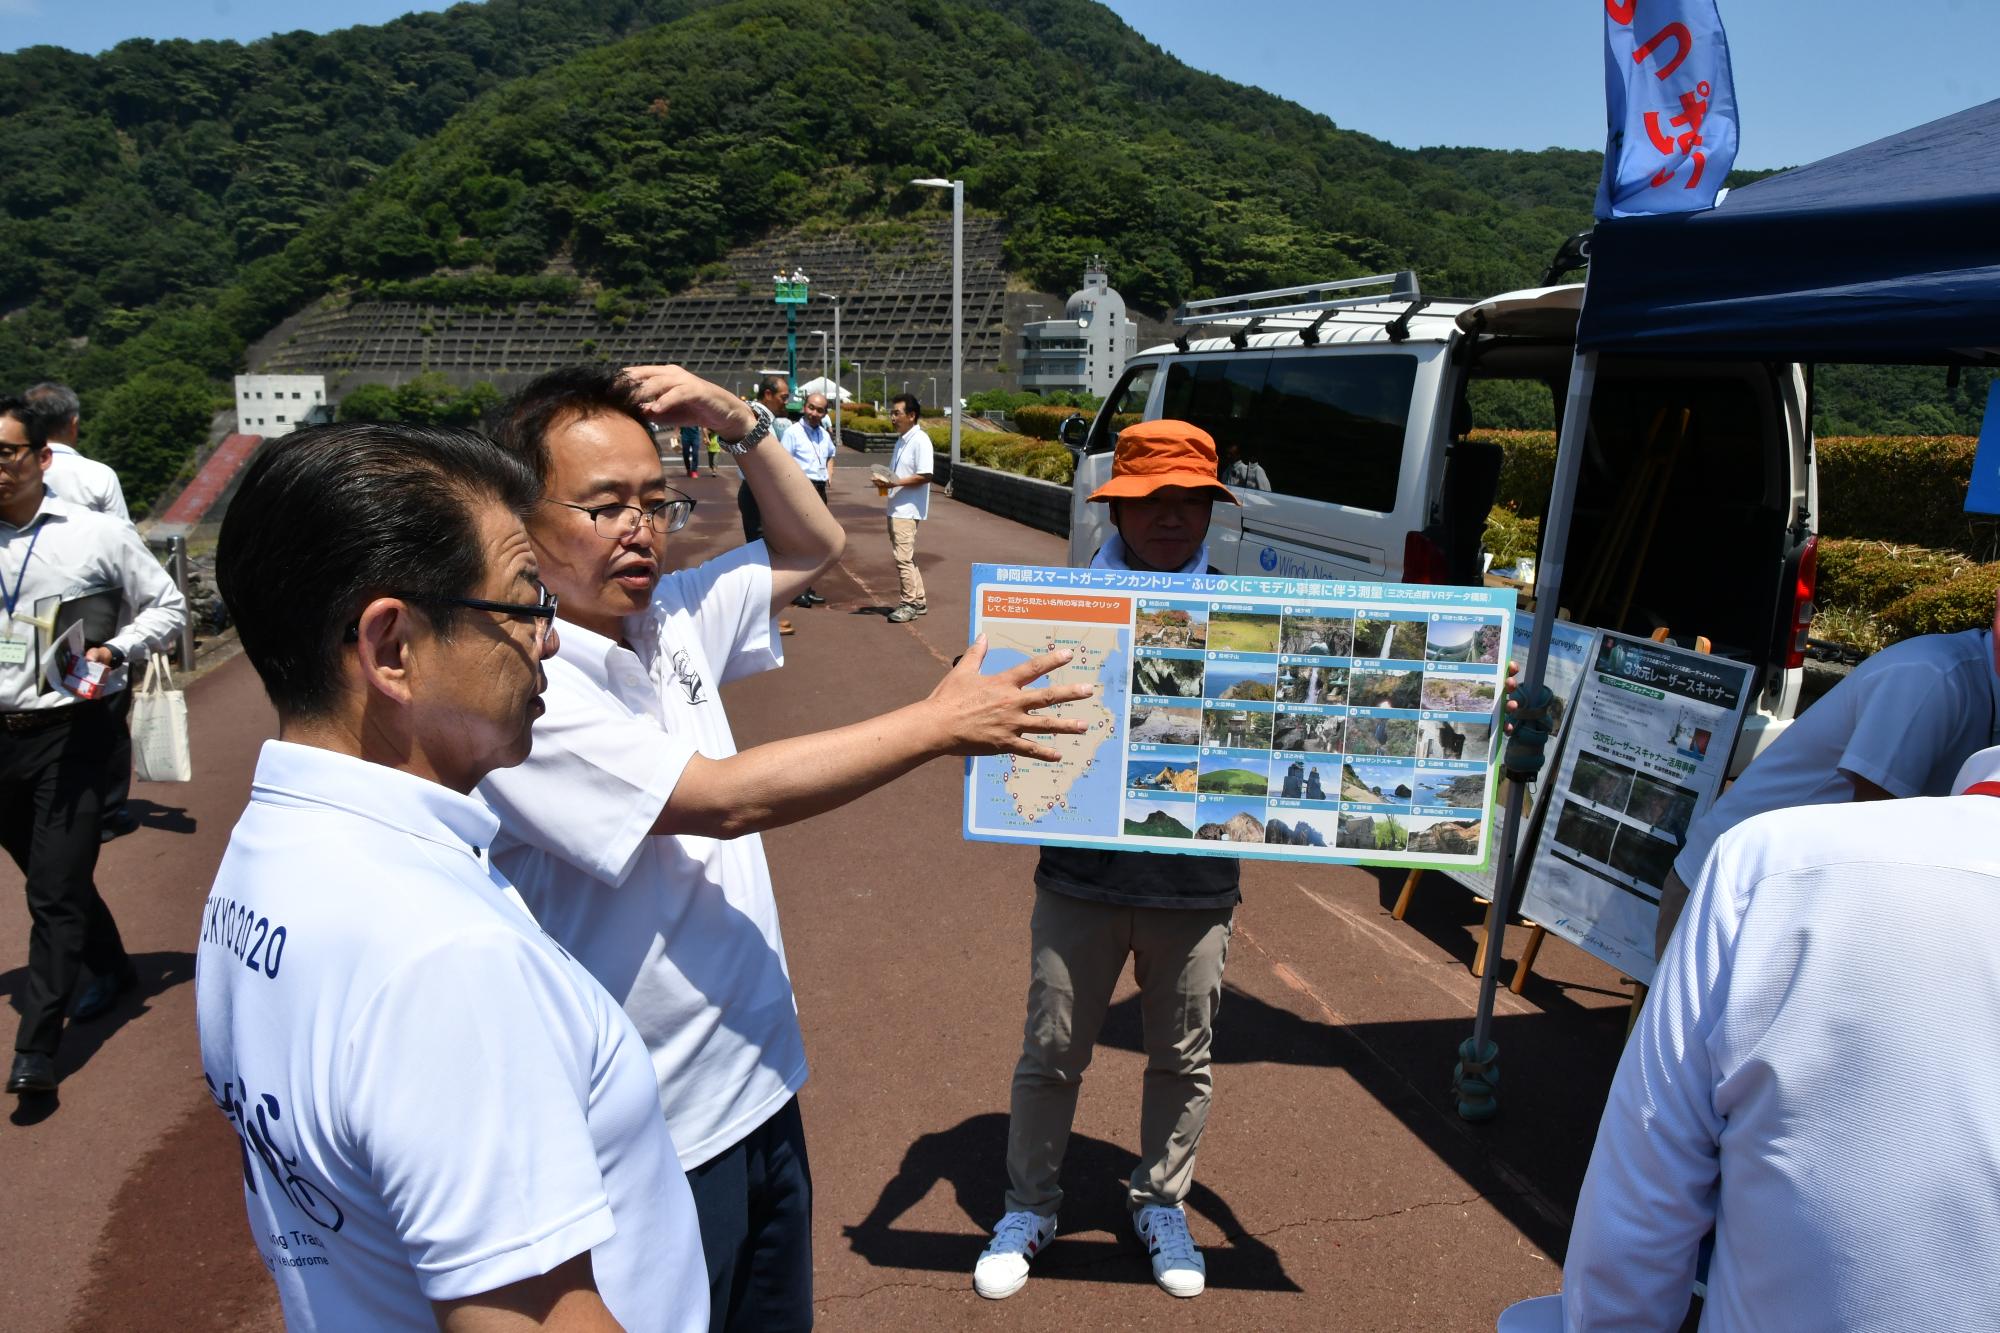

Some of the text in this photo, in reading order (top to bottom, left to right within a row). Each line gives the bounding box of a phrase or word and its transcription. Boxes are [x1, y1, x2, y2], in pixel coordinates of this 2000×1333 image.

[987, 605, 1029, 614] してください
[1551, 638, 1583, 654] surveying
[1623, 660, 1736, 700] 3次元レーザースキャナー
